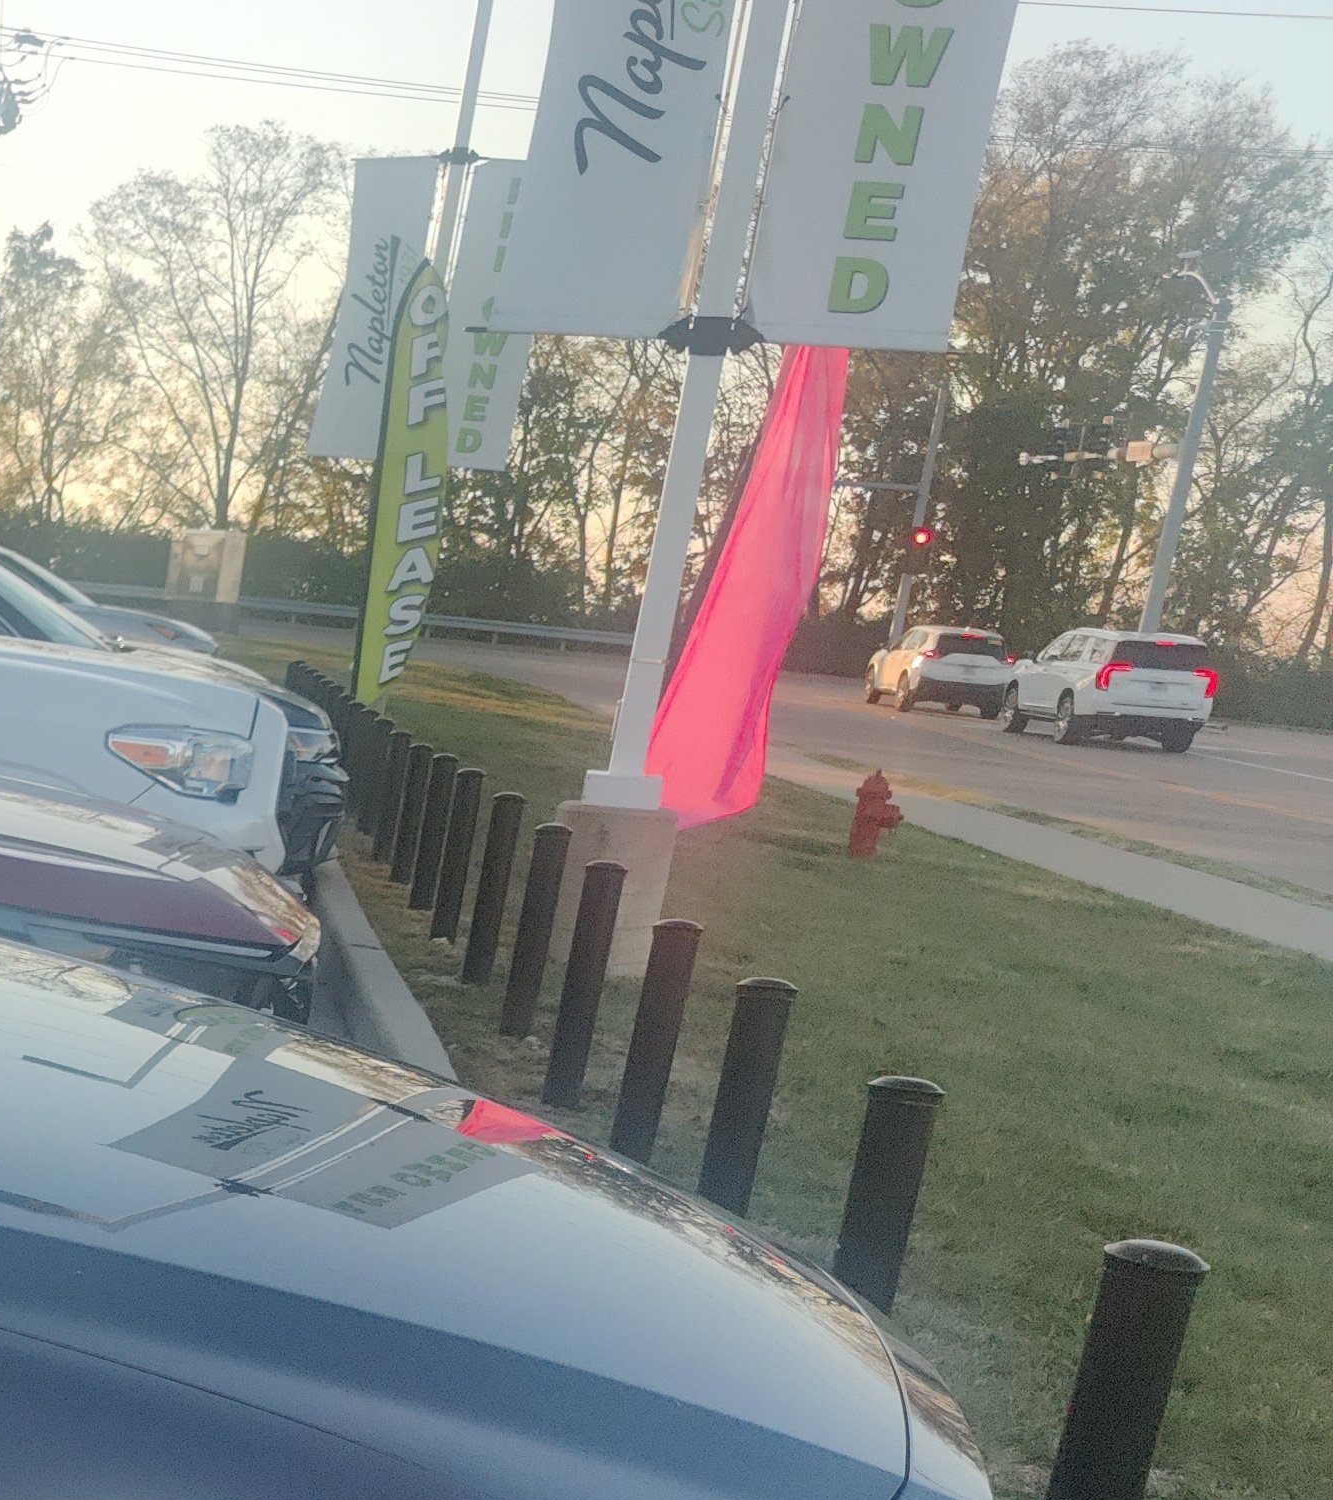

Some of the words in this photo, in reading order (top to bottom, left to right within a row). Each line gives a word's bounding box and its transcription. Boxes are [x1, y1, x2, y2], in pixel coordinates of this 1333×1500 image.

[575, 0, 707, 176] Nap
[827, 0, 955, 314] WNED
[344, 237, 392, 386] Napleton
[406, 284, 449, 428] OFF
[378, 453, 442, 685] LEASE
